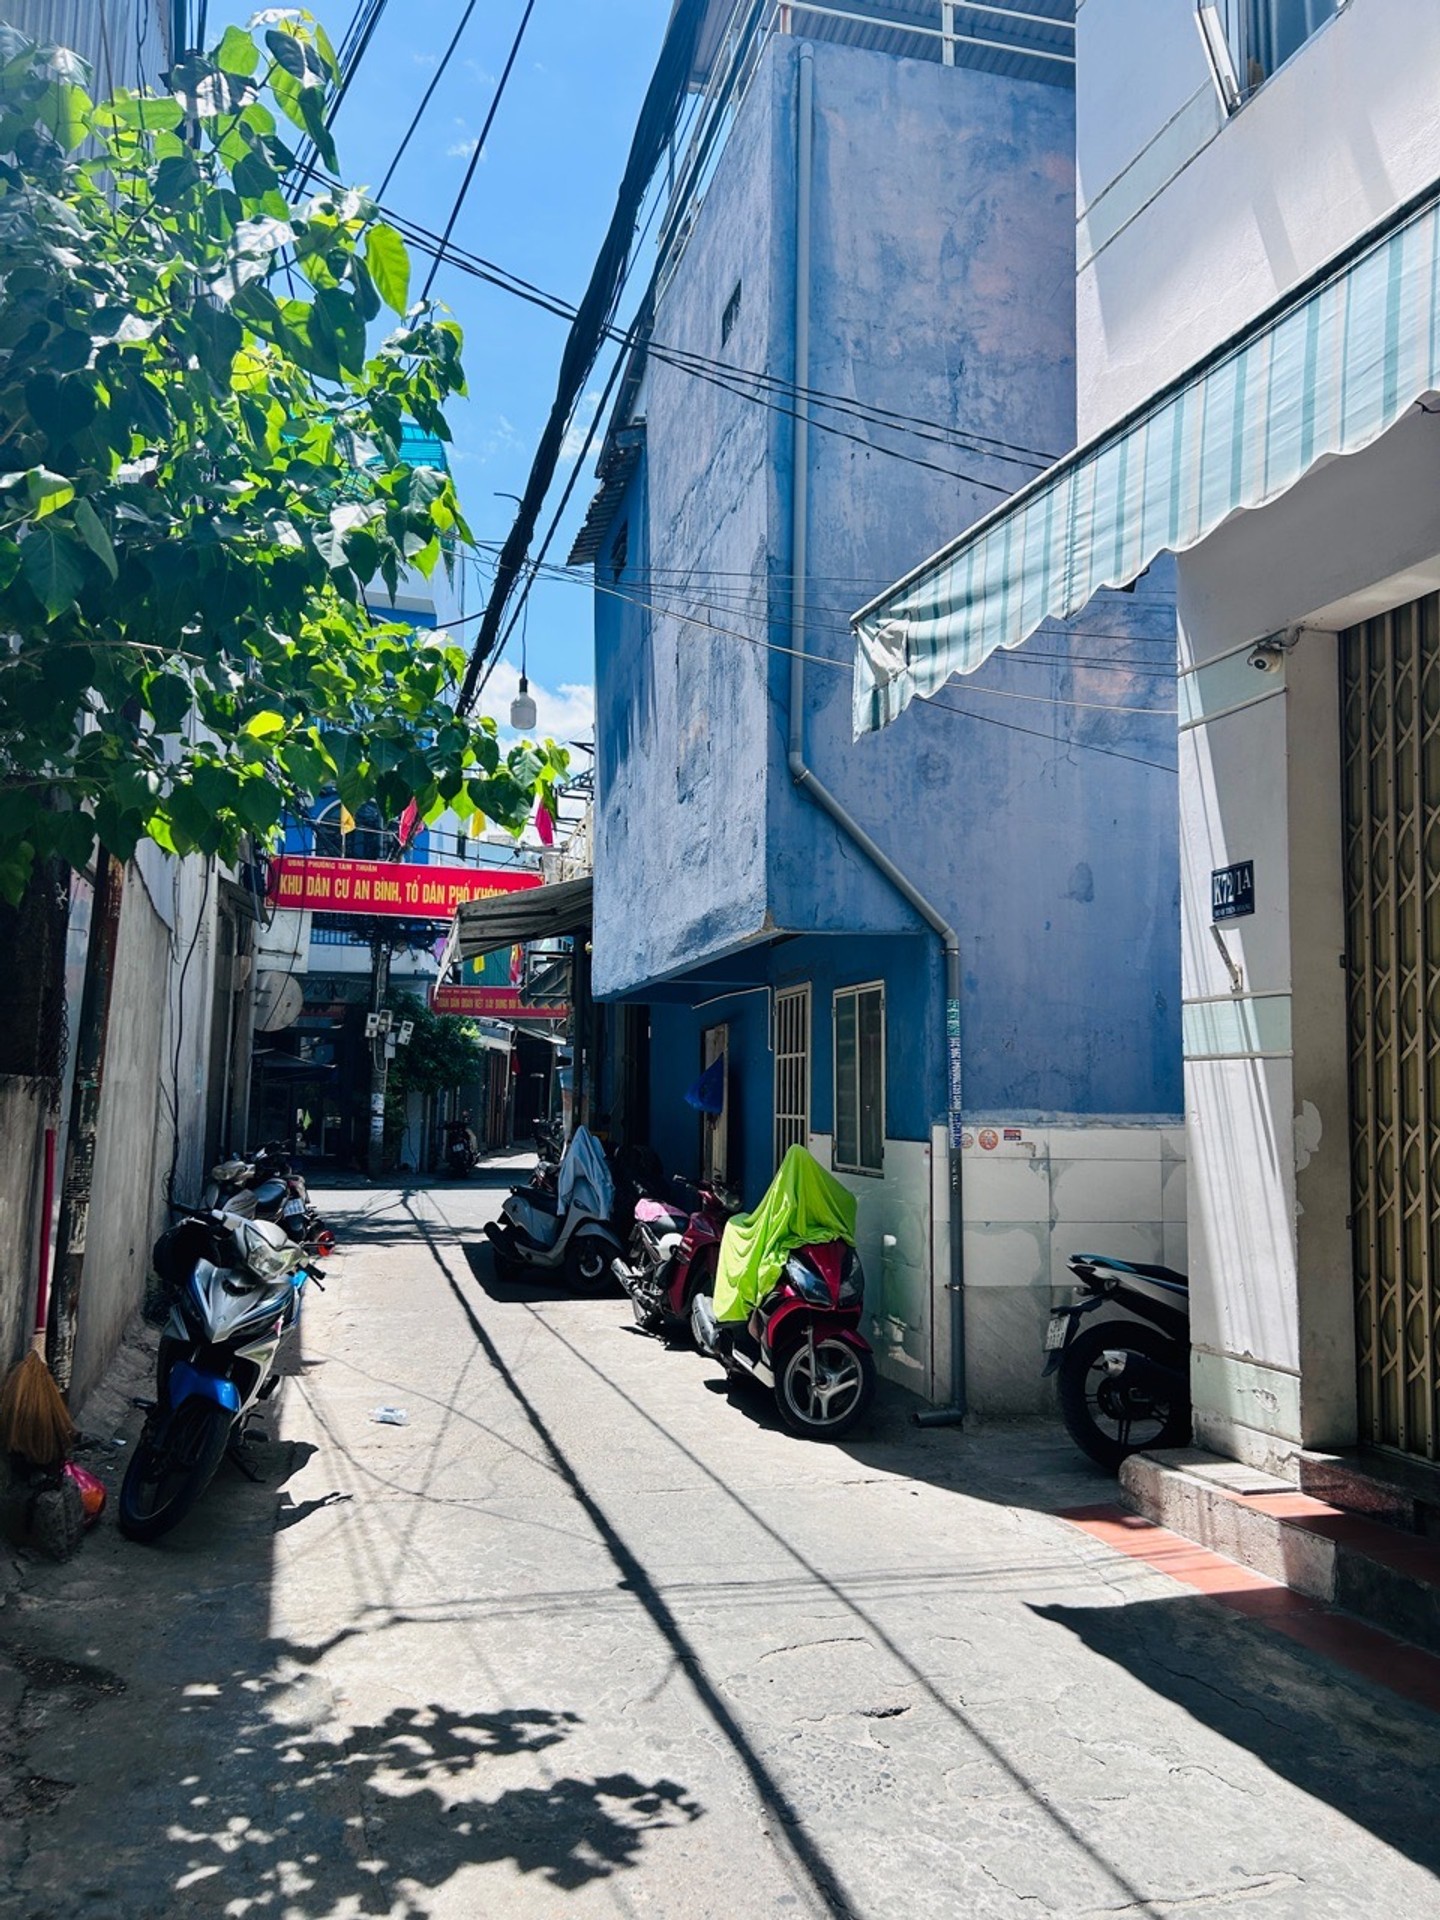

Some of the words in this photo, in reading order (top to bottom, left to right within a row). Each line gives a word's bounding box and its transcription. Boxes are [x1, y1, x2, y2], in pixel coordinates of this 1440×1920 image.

[280, 874, 303, 896] KHU
[306, 873, 330, 897] DÂN
[335, 877, 350, 899] CƯ
[354, 879, 370, 900] AN
[374, 876, 402, 904] BÌNH,
[405, 874, 421, 903] TỔ
[423, 881, 445, 905] DÂN
[449, 880, 471, 905] PHỐ
